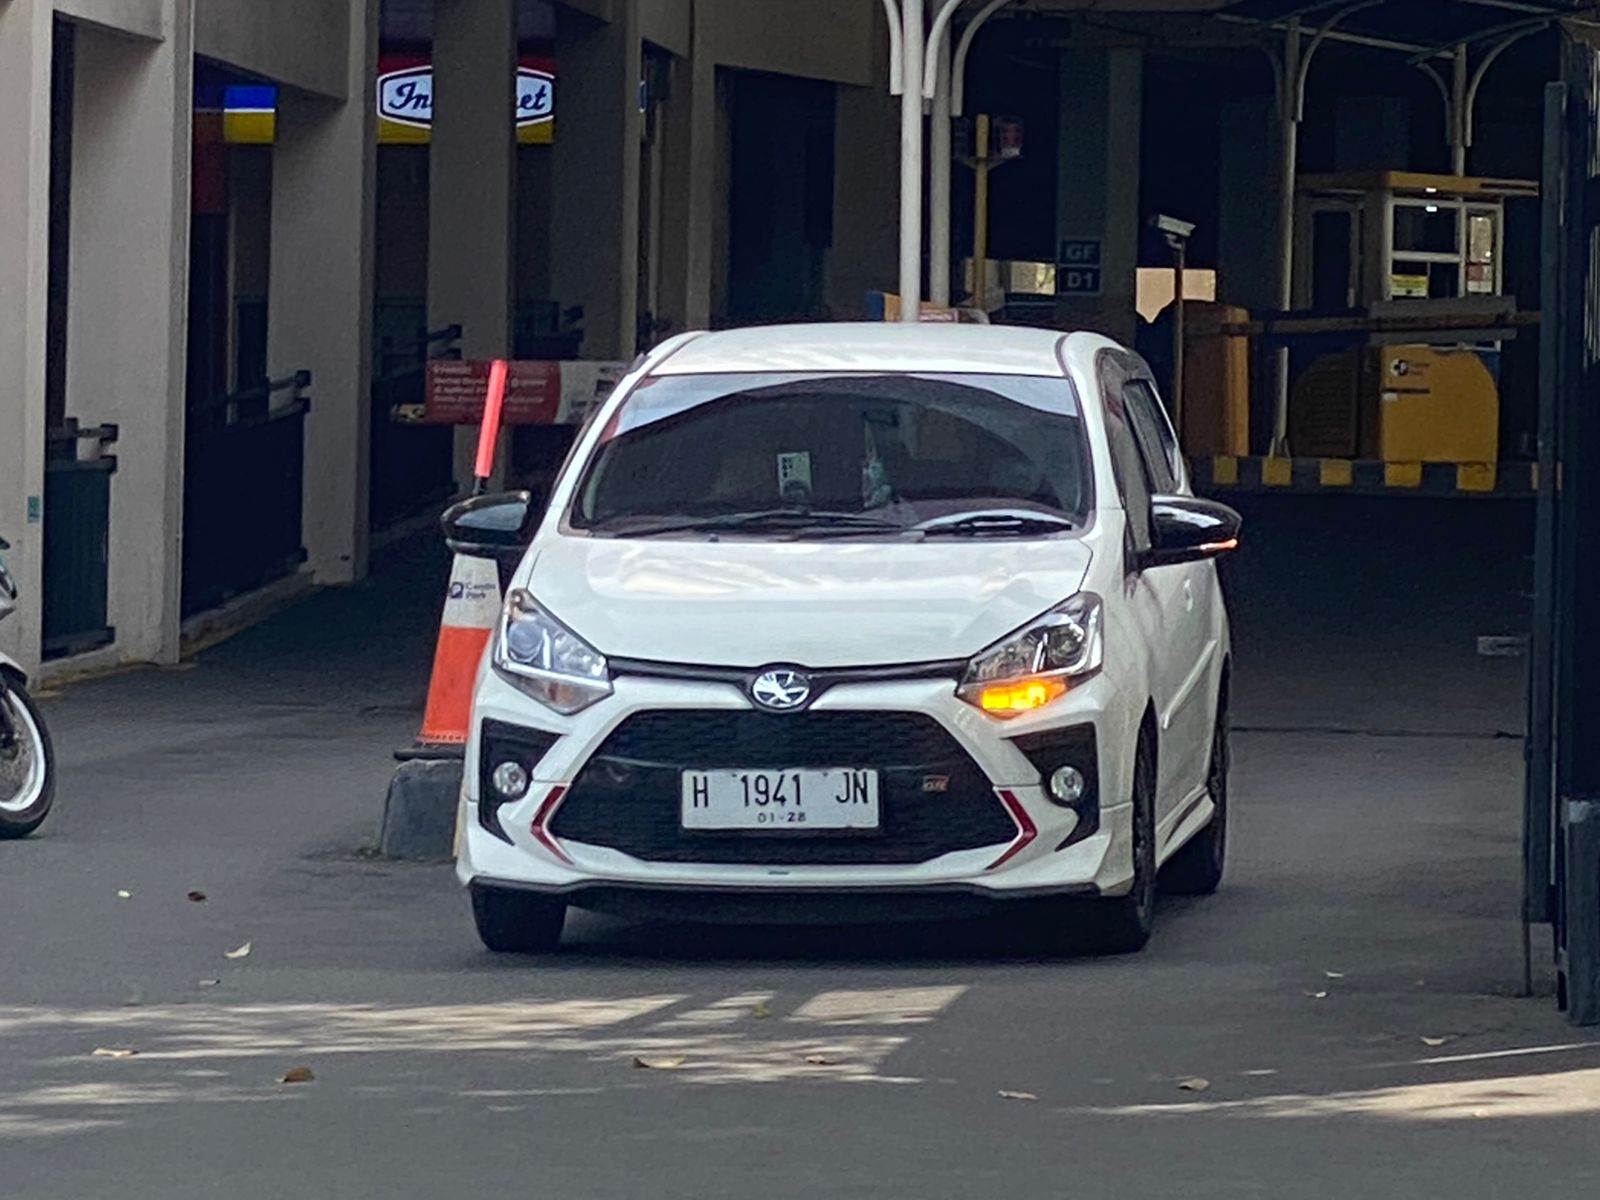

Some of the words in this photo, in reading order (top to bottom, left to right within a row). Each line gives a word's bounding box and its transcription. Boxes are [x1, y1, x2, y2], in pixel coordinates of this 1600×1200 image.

[1066, 244, 1096, 260] GF
[1067, 272, 1093, 288] D1
[693, 775, 708, 808] H
[740, 774, 802, 807] 1941
[836, 772, 868, 804] JN
